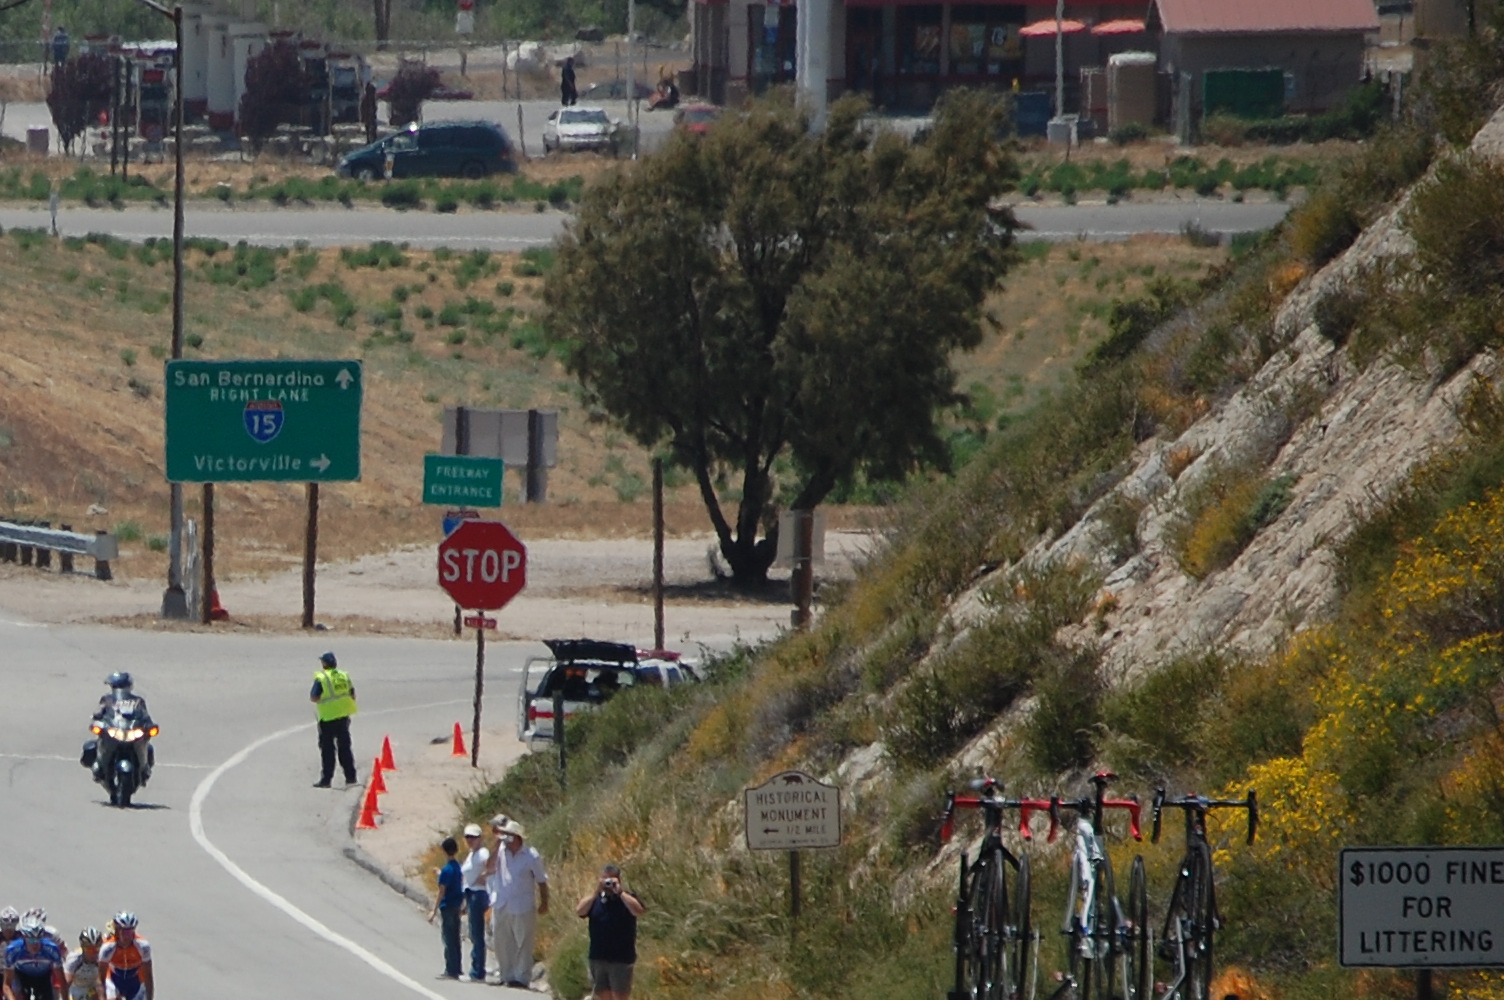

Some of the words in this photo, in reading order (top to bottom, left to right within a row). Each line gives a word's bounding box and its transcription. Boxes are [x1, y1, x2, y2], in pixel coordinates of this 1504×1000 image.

[174, 370, 210, 386] San
[218, 370, 325, 386] Bernardino
[210, 388, 260, 401] RIGHT
[268, 388, 309, 402] LANE
[252, 414, 276, 434] 15
[194, 454, 301, 472] Victorville
[436, 466, 490, 479] FREEWAY
[431, 484, 493, 498] ENTRANCE
[443, 549, 521, 583] STOP
[756, 790, 827, 806] HISTORICAL
[760, 808, 827, 822] MONUMENT
[805, 824, 827, 834] MILE
[1350, 860, 1431, 887] $1000
[1447, 861, 1504, 884] FINE
[1402, 896, 1452, 918] FOR
[1360, 930, 1494, 953] LITTERING
